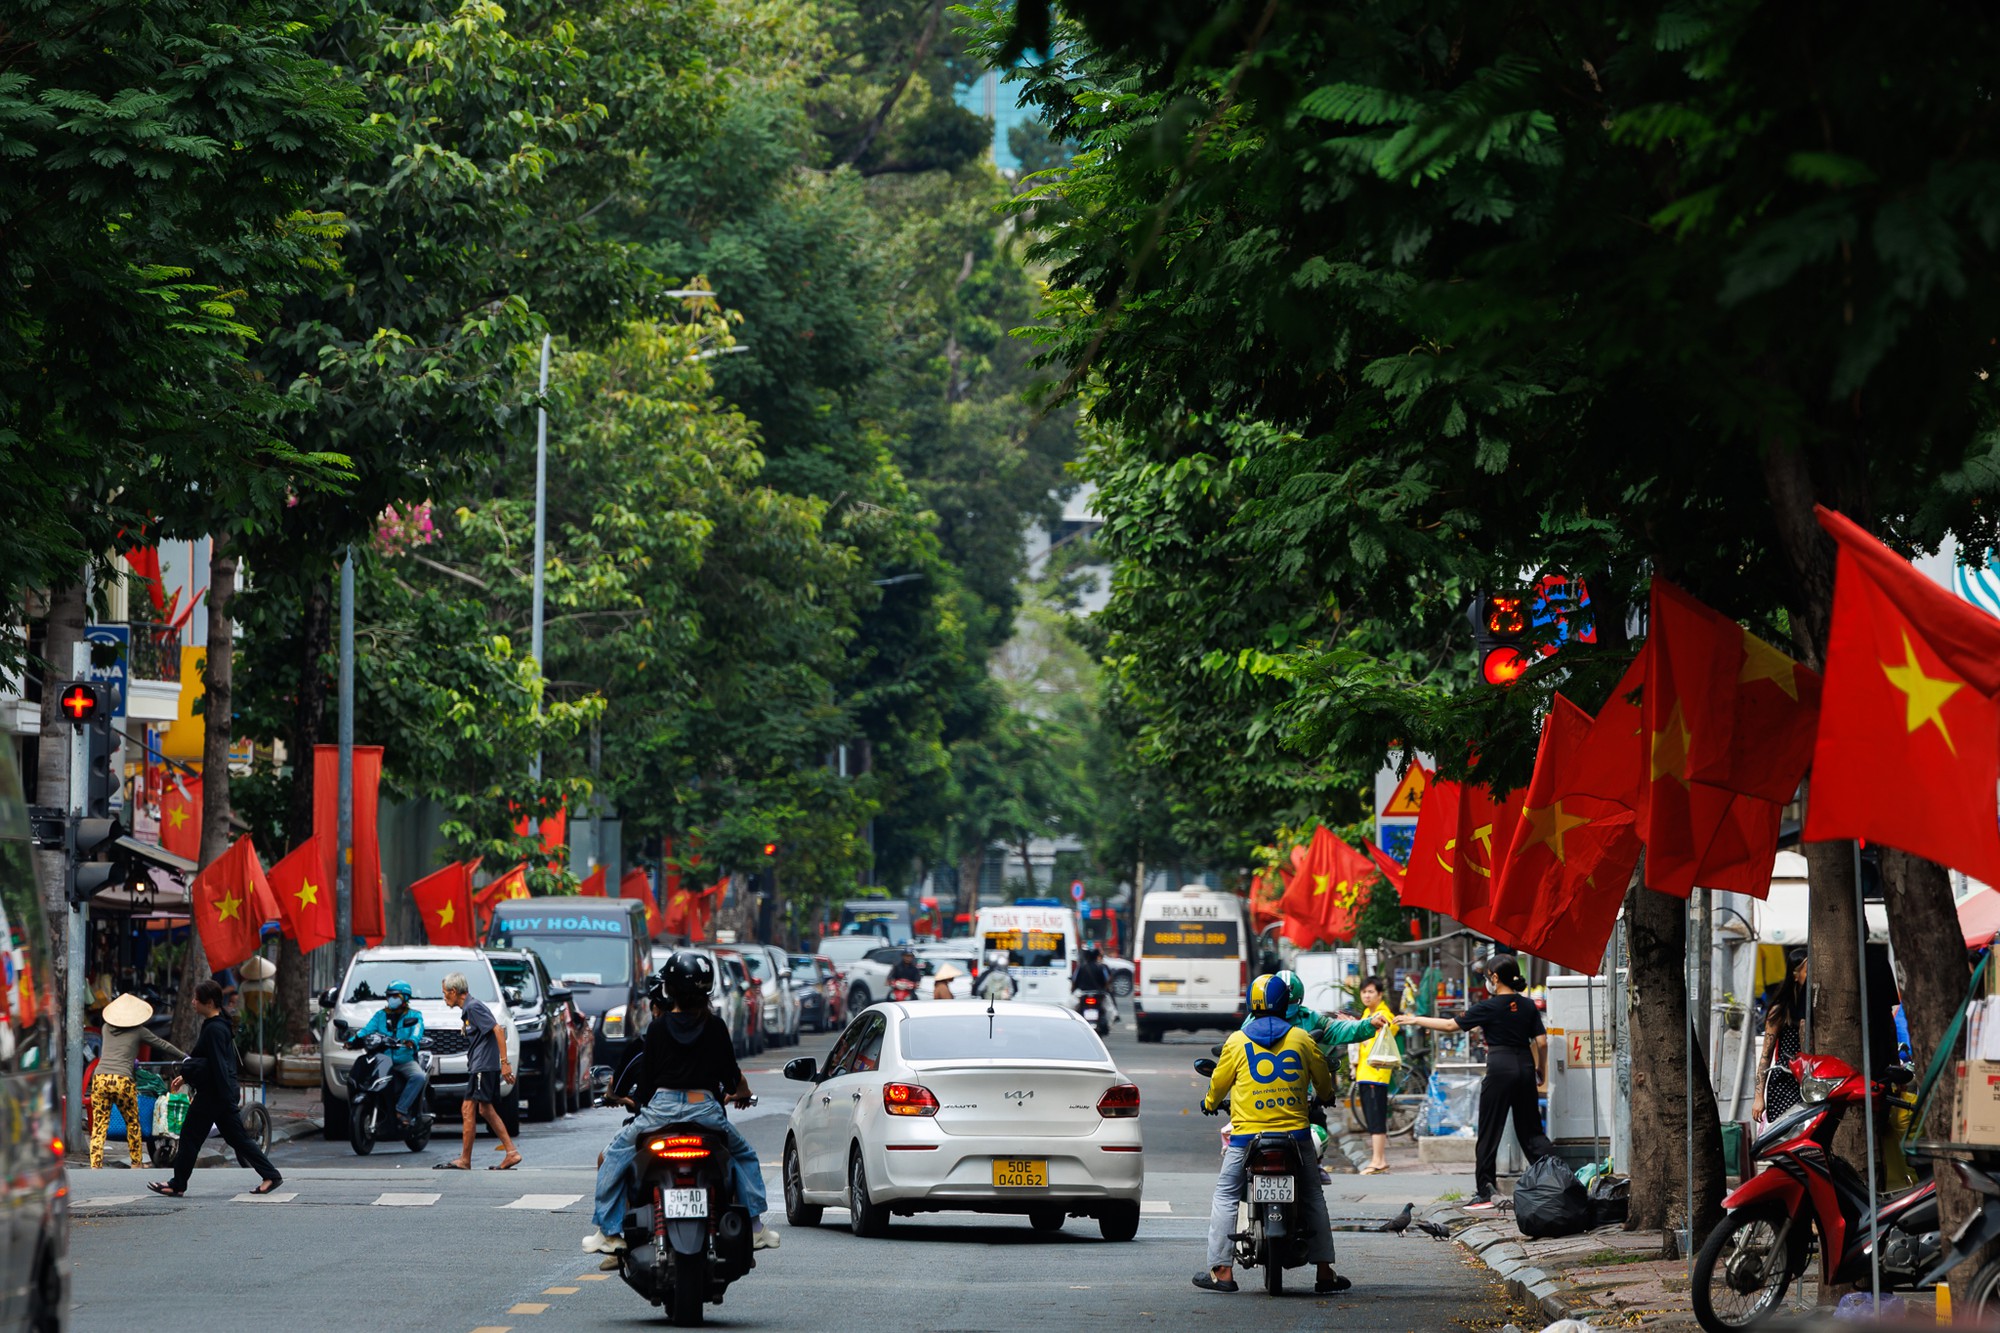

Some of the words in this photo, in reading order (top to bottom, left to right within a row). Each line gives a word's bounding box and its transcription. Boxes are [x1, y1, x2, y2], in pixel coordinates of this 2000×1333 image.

[1162, 906, 1189, 917] HOA
[1193, 906, 1218, 917] MAI
[501, 918, 542, 931] HUY
[547, 915, 621, 932] HOÀNG
[1244, 1042, 1303, 1084] be
[1008, 1161, 1032, 1173] 50E
[998, 1174, 1042, 1186] 040.62
[1256, 1189, 1292, 1200] 025.62
